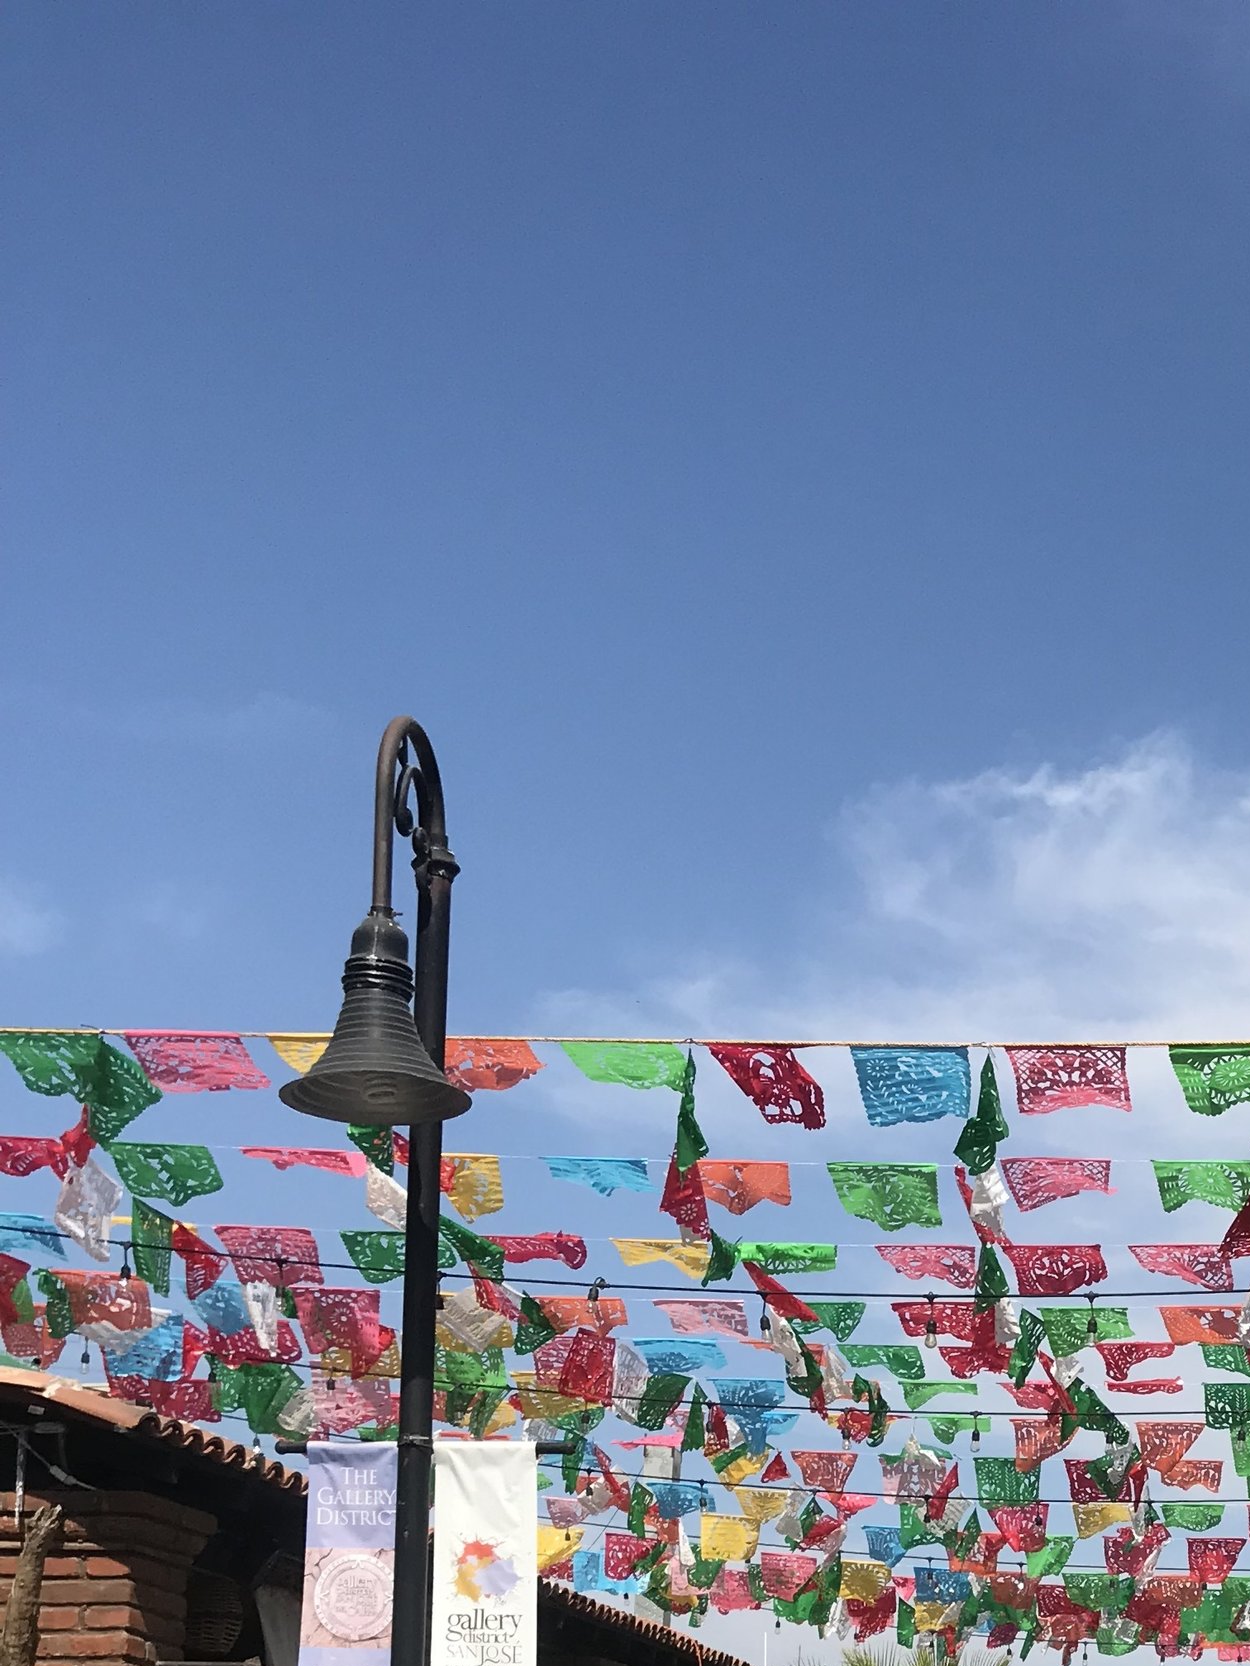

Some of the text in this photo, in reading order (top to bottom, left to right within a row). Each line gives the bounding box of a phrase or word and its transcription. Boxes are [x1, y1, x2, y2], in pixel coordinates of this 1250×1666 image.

[341, 1466, 378, 1485] THE
[317, 1486, 396, 1505] GALLERY
[445, 1608, 523, 1642] gallery
[463, 1629, 509, 1644] district
